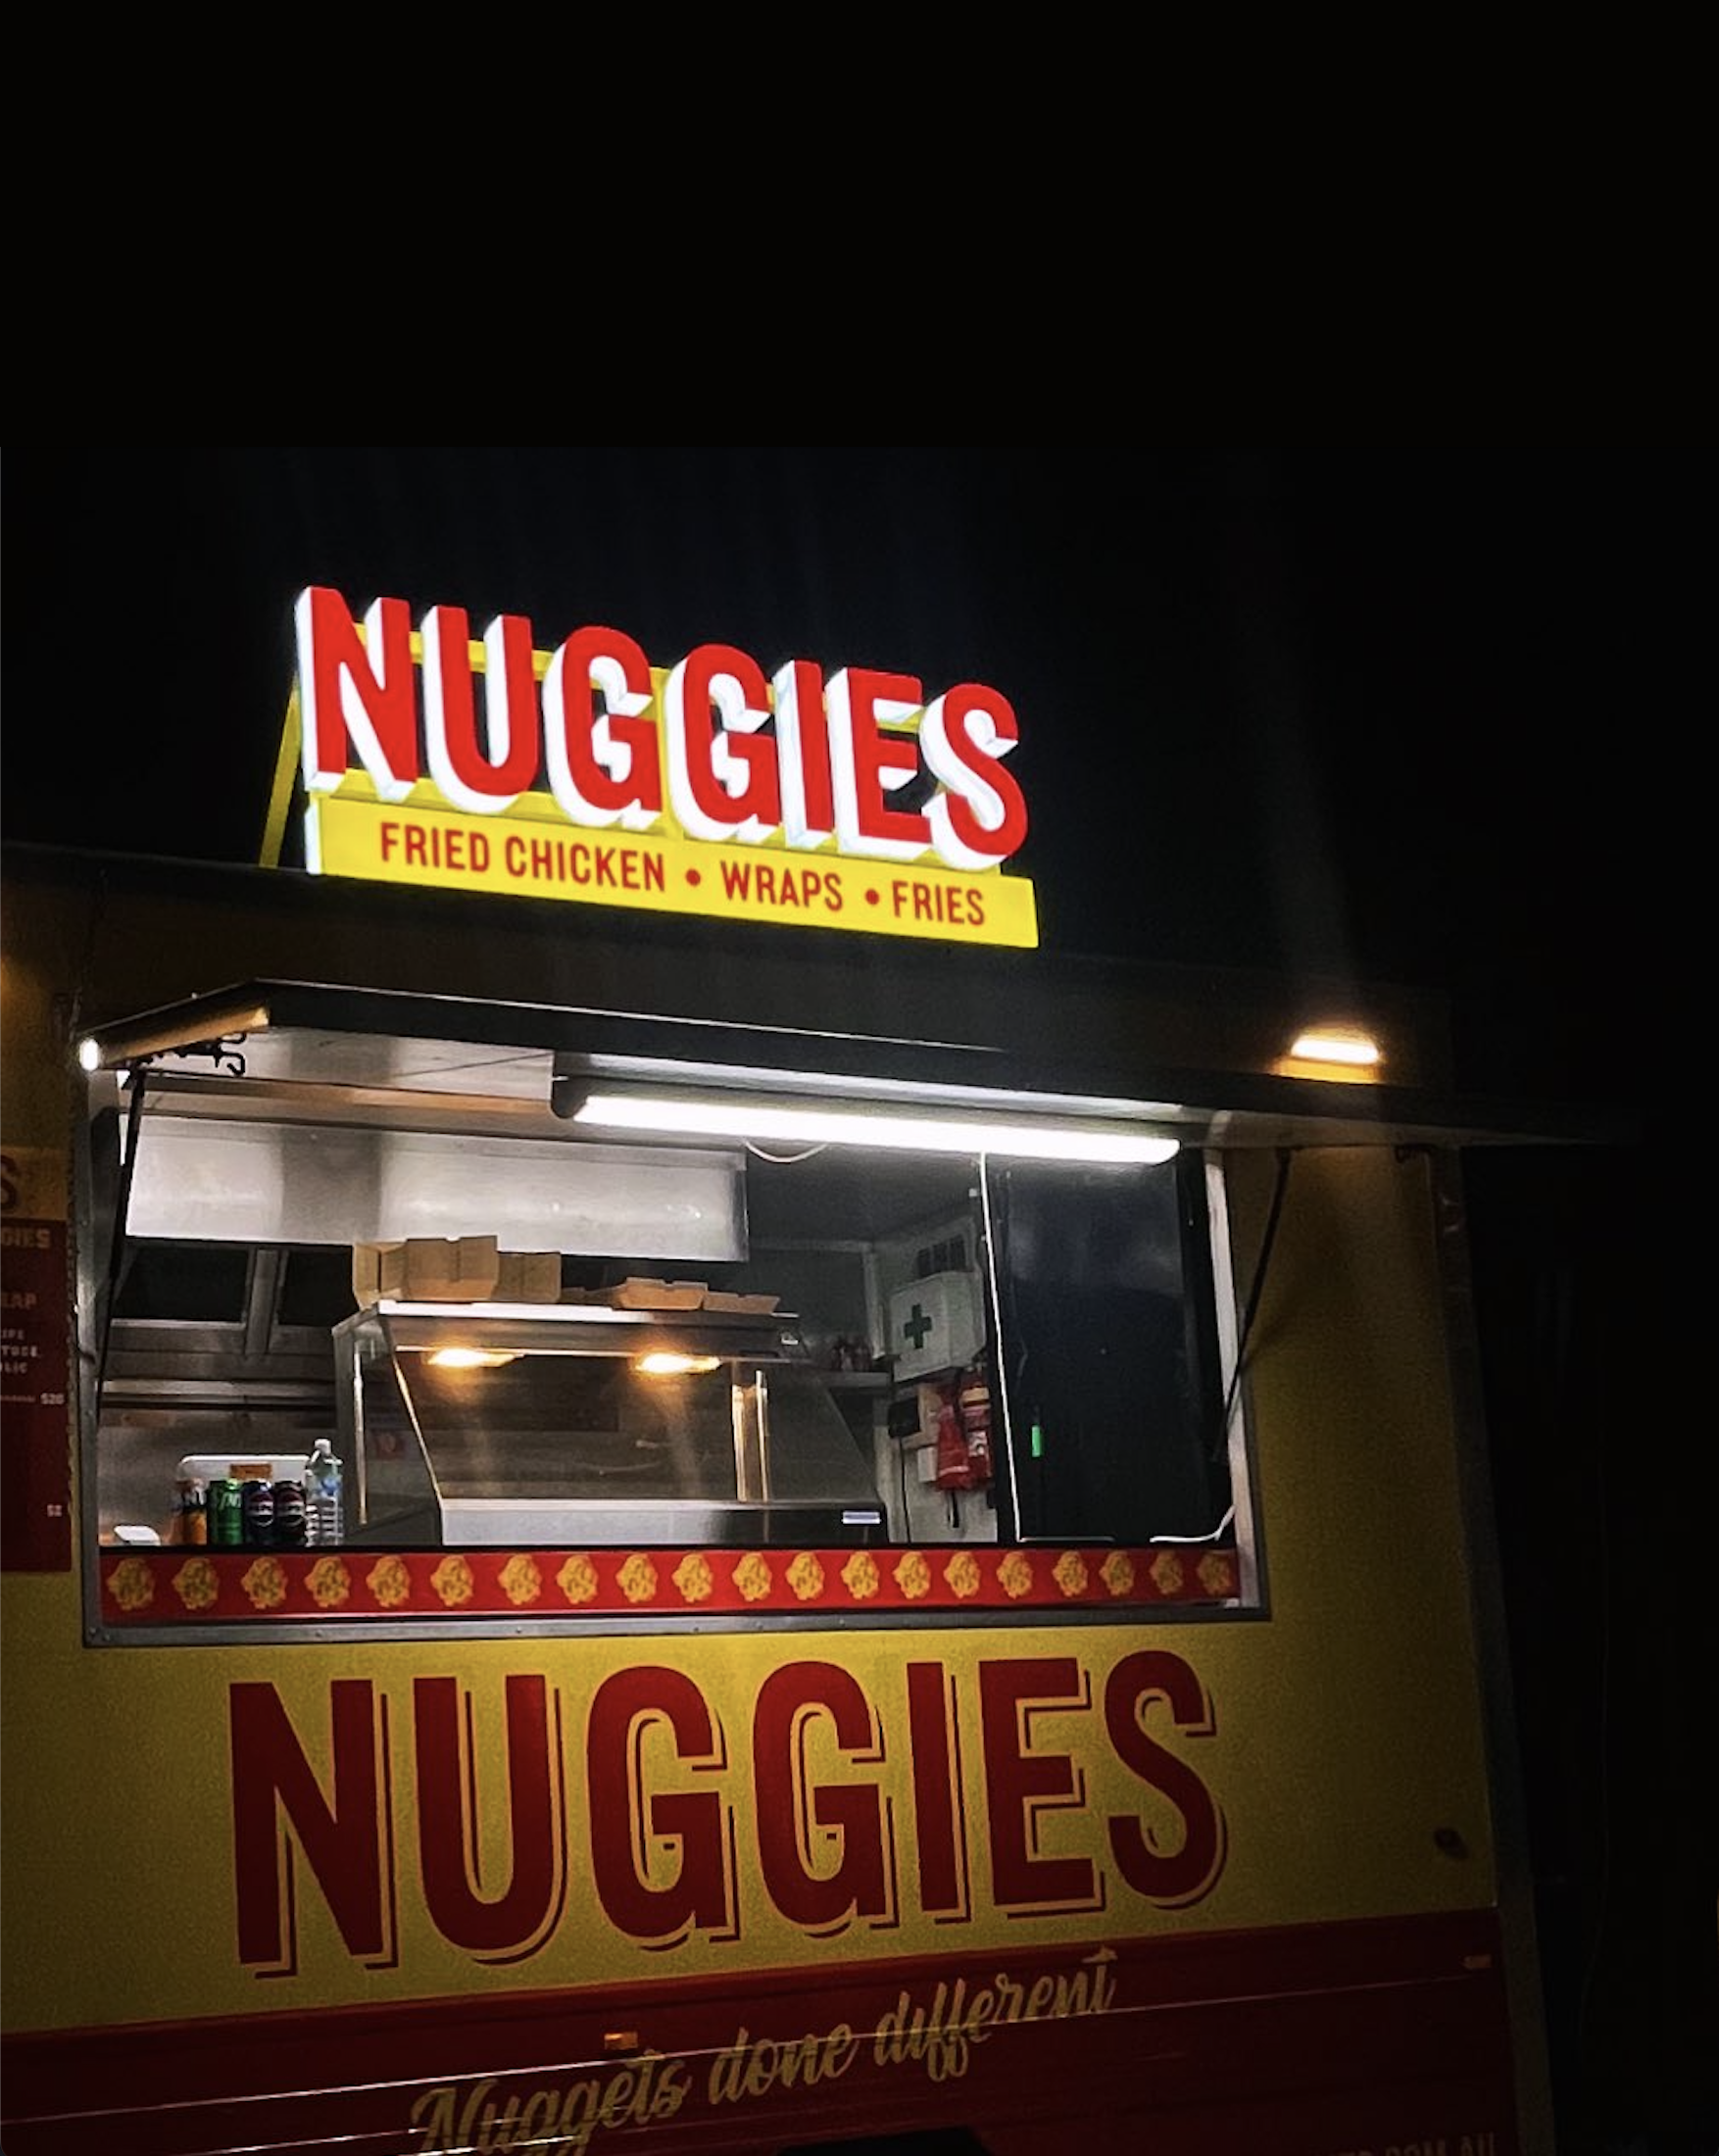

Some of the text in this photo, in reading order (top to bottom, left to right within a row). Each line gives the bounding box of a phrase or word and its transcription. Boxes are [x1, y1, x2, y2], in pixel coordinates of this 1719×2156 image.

[296, 585, 1029, 870] NUGGIES
[380, 822, 985, 927] FRIED CHICKEN WRAPS FRIES
[229, 1650, 1226, 1978] NUGGIES
[409, 1944, 1119, 2156] Nuggets done different
